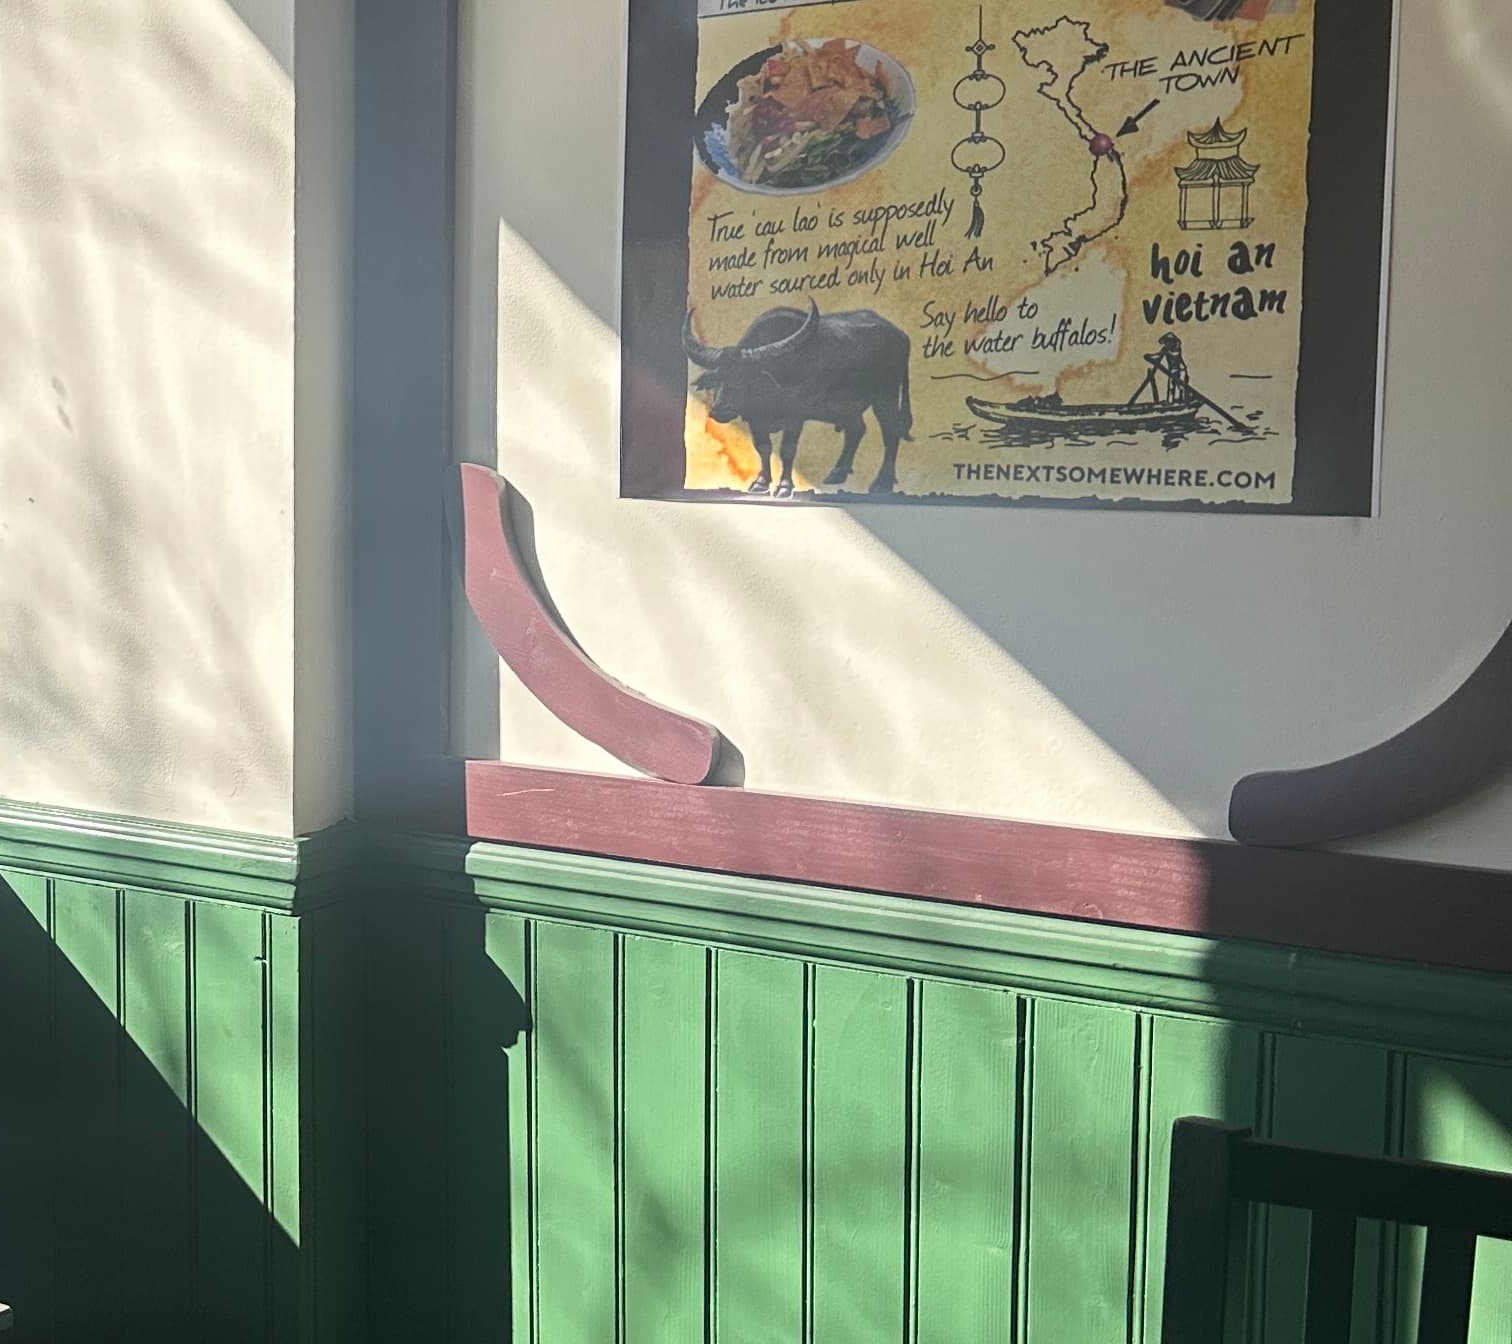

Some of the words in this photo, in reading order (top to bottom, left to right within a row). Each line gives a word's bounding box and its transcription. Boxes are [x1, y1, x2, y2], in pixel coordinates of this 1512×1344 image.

[1104, 56, 1159, 81] THE
[1169, 33, 1306, 71] ANCIENT
[1159, 64, 1240, 94] TOWN
[707, 211, 745, 243] True
[828, 207, 844, 228] is
[852, 187, 955, 236] supposedly
[708, 248, 757, 273] made
[763, 238, 808, 269] from
[817, 228, 886, 269] magical
[896, 219, 937, 249] well
[1151, 242, 1203, 285] hoi
[1227, 240, 1276, 275] an
[711, 276, 763, 301] water
[769, 266, 841, 294] sourced
[847, 257, 886, 295] only
[893, 263, 910, 281] in
[919, 251, 953, 279] Hoi
[962, 246, 994, 273] An
[919, 300, 956, 338] Say
[963, 294, 1008, 324] hello
[1017, 296, 1039, 320] to
[1142, 286, 1288, 325] vietnam
[922, 335, 955, 359] the
[964, 330, 1024, 355] water
[1031, 313, 1117, 352] buffalos!
[953, 463, 1276, 489] THENEXTSOMEWHERE.COM
